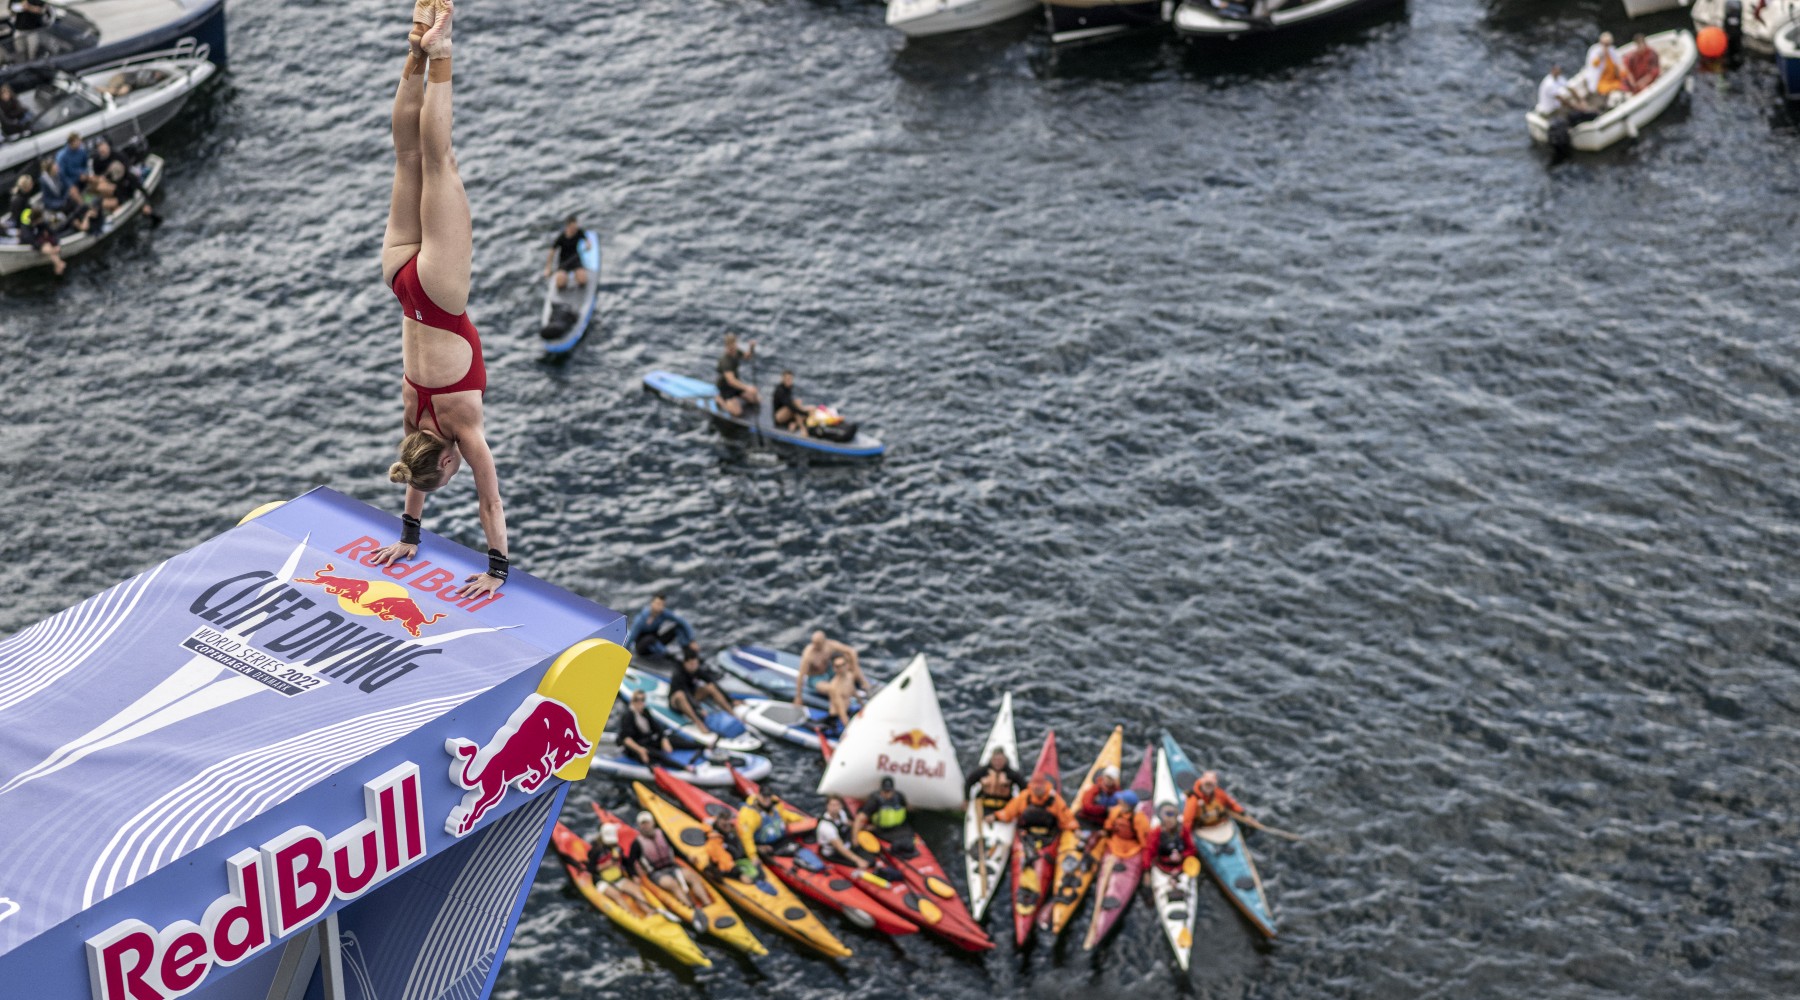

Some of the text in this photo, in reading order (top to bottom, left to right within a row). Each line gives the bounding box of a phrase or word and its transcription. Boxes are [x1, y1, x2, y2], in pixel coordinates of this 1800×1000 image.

[407, 567, 505, 613] Bull
[189, 570, 443, 694] CLIFF DIVING
[195, 628, 321, 690] WORLD SERIES 2022
[194, 644, 292, 692] COPENHAGEN DENMARK
[877, 753, 946, 779] Red Bull
[102, 773, 423, 1000] Red Bull
